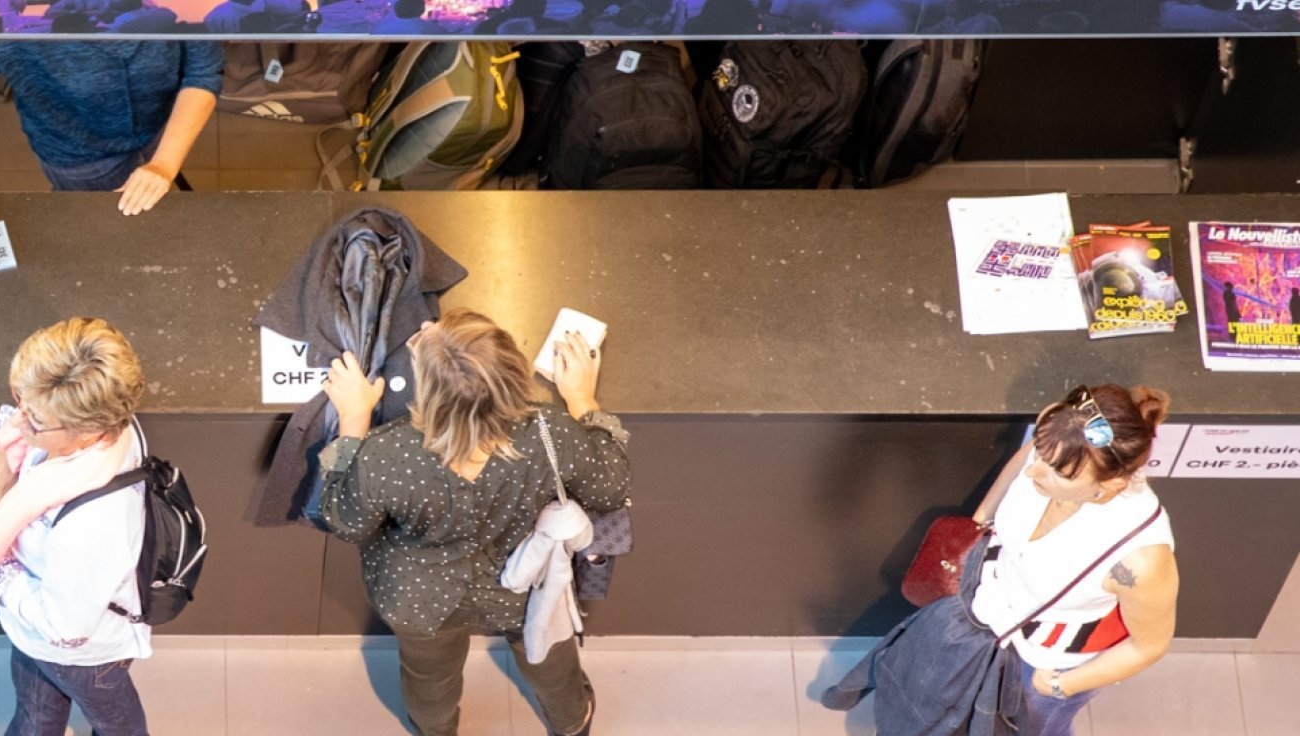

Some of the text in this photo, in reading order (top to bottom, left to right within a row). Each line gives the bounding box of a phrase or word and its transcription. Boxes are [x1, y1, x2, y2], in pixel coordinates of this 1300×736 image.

[1208, 227, 1226, 240] Le
[273, 371, 315, 385] CHF
[1215, 445, 1300, 454] Vestiair
[1186, 460, 1231, 468] CHF
[1266, 459, 1300, 470] piè
